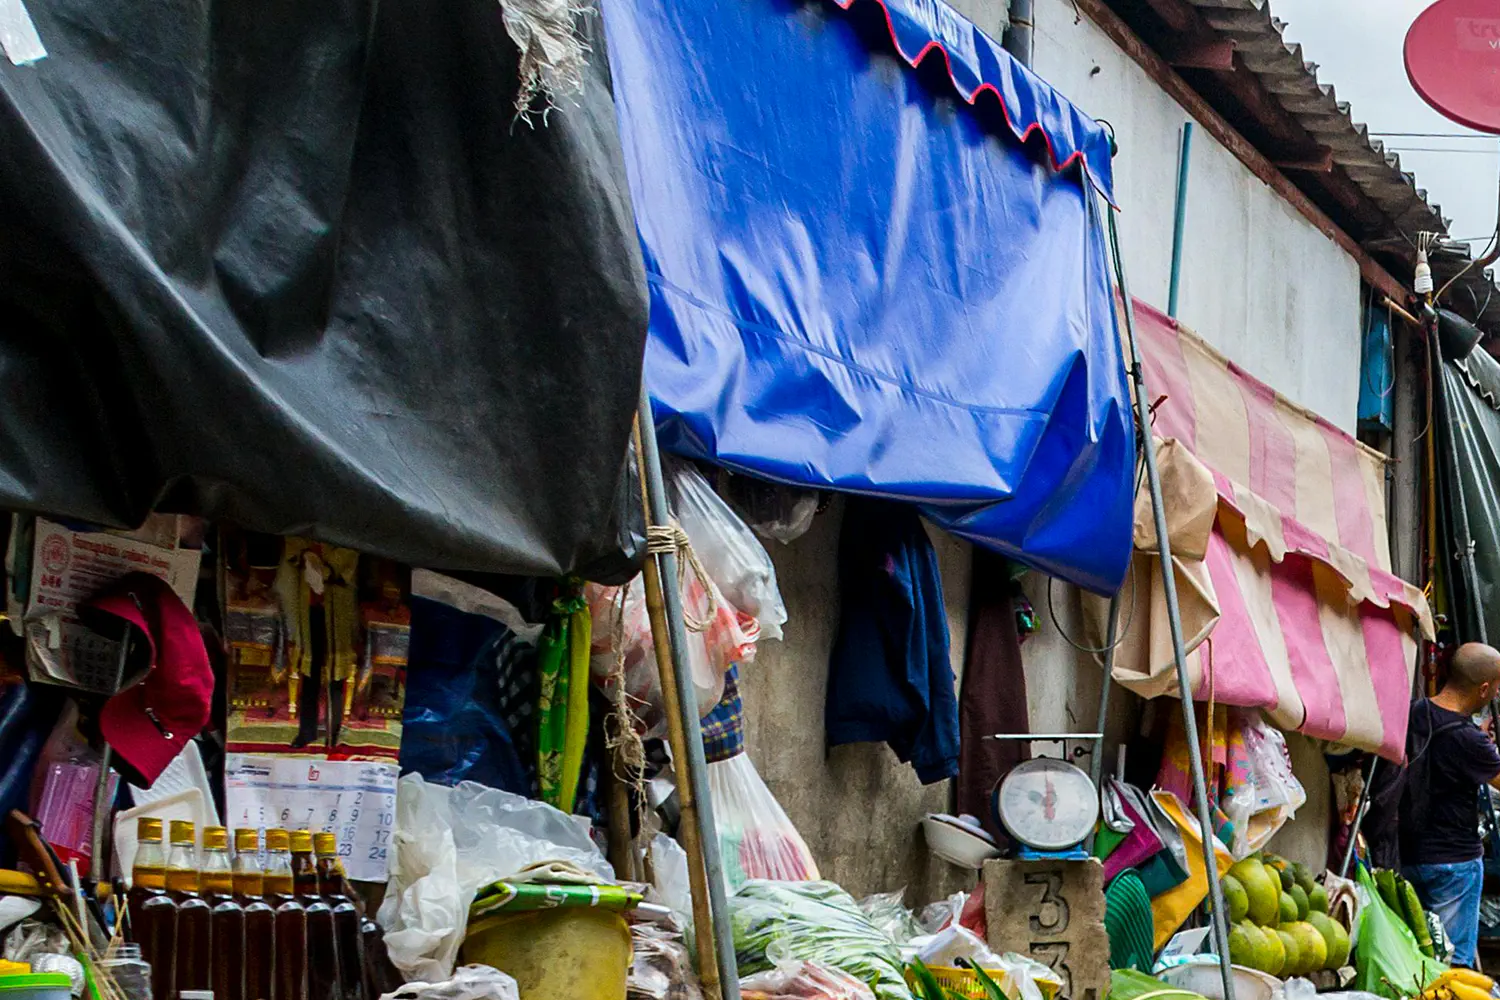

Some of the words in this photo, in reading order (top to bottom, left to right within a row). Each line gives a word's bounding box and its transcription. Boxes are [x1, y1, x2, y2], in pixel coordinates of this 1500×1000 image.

[354, 792, 363, 805] 2
[385, 797, 393, 808] 3
[281, 808, 290, 820] 6
[306, 808, 315, 820] 7
[329, 809, 338, 821] 8
[350, 809, 359, 821] 9
[378, 813, 393, 826] 10
[343, 826, 356, 840] 16
[375, 830, 391, 843] 17
[338, 844, 353, 857] 23
[368, 847, 387, 860] 24
